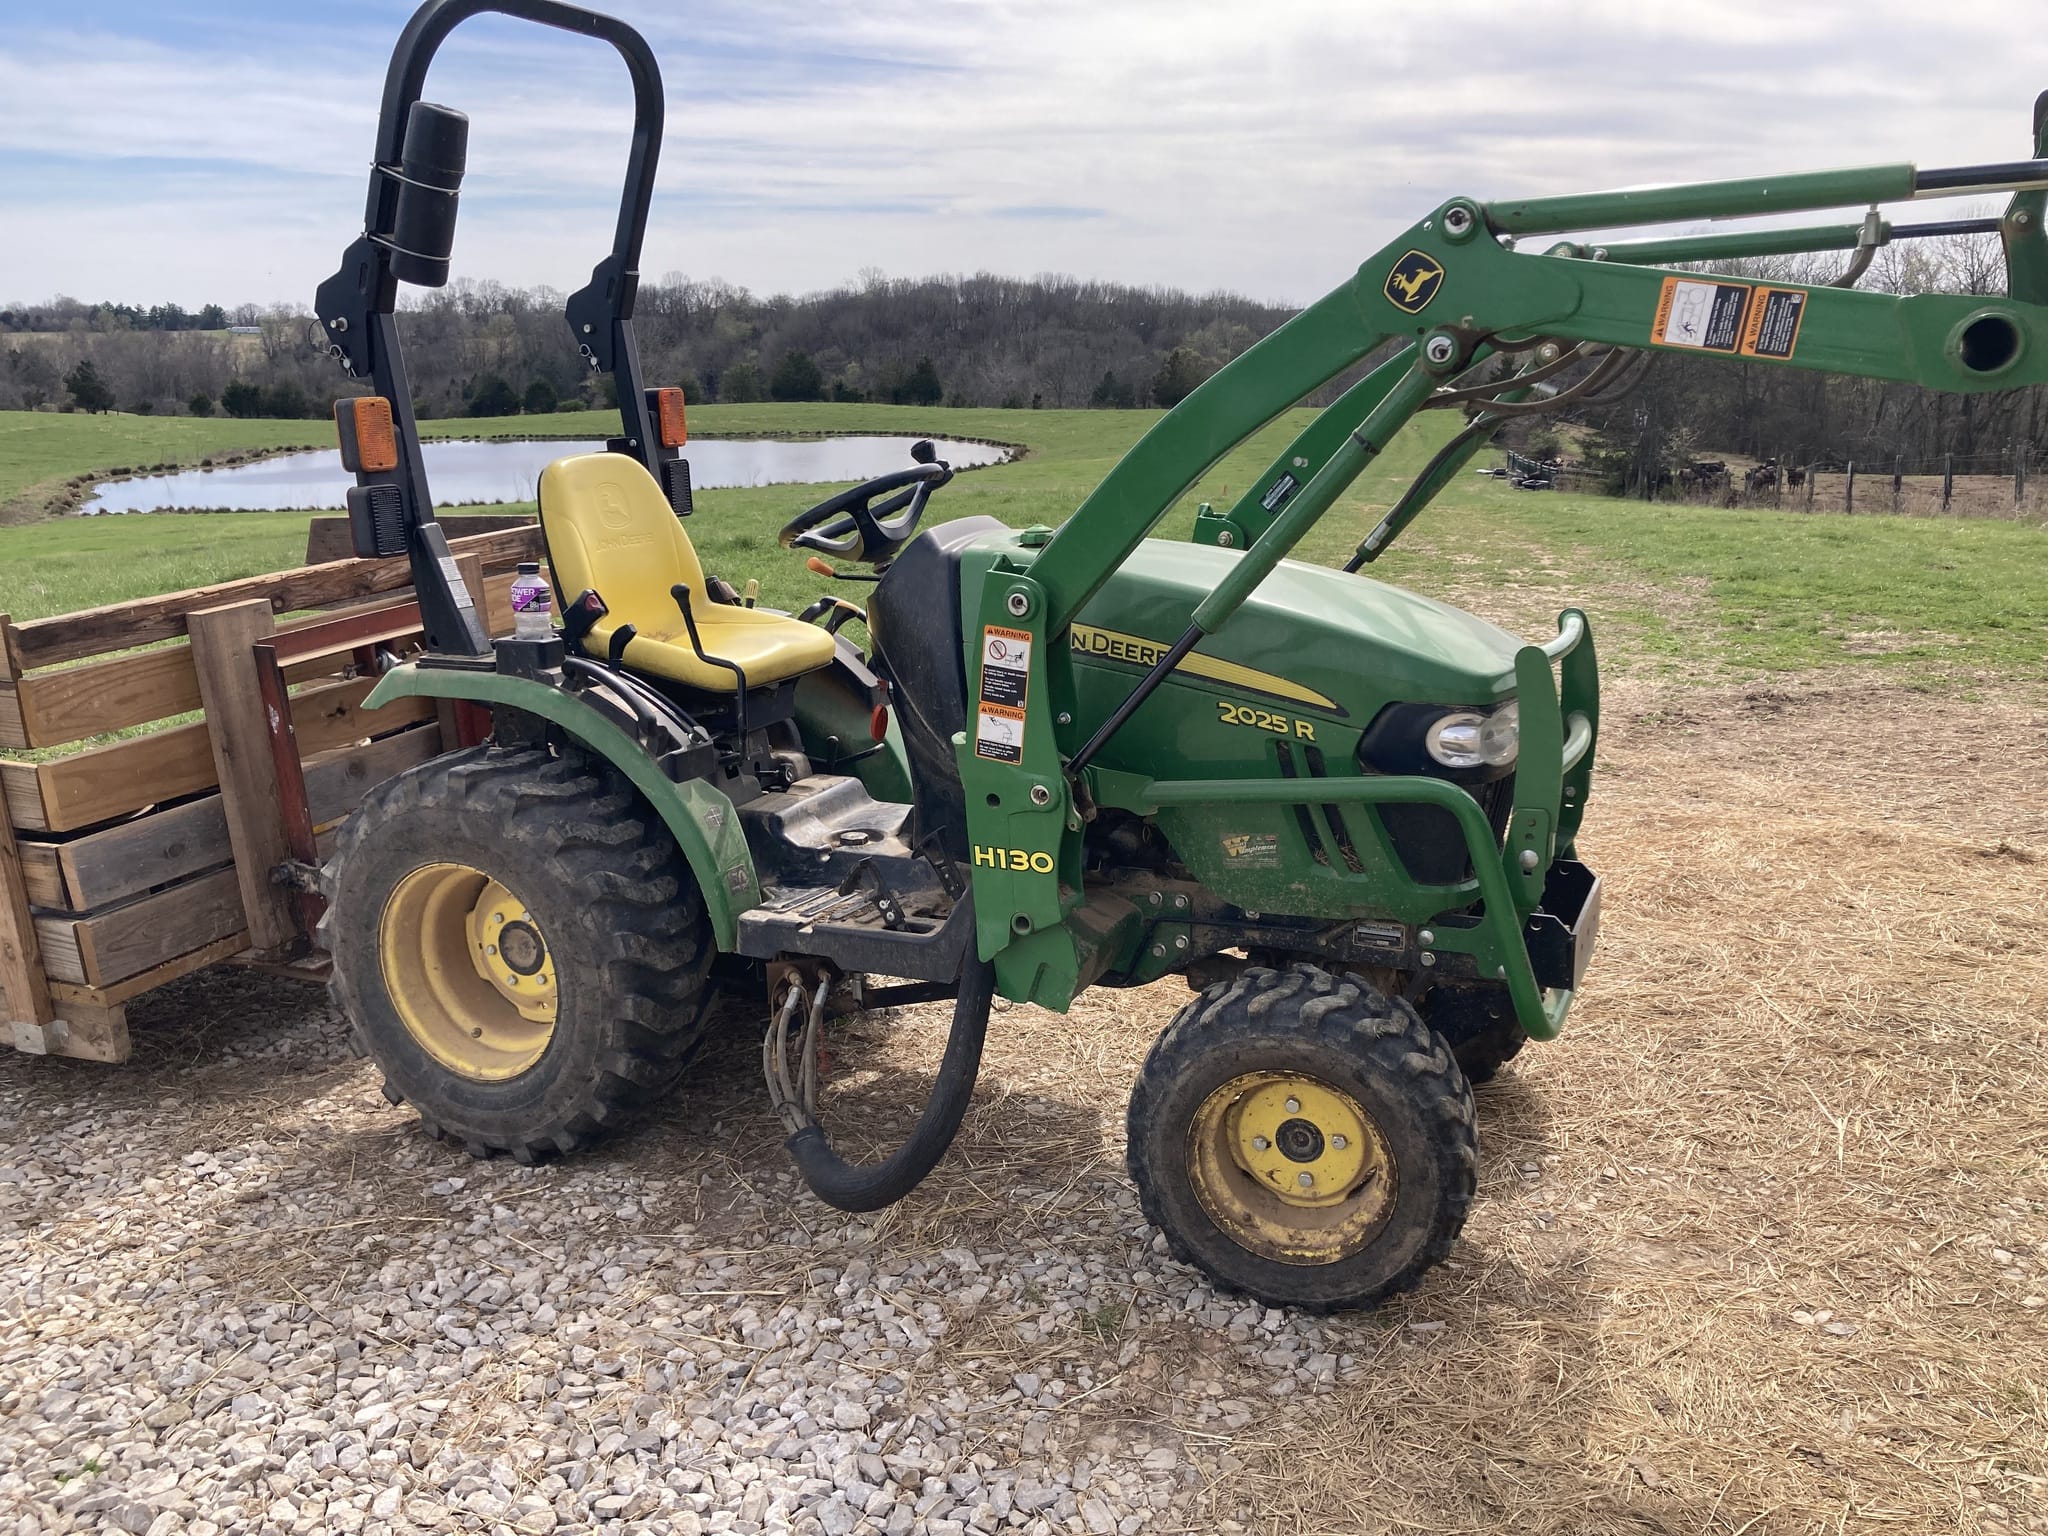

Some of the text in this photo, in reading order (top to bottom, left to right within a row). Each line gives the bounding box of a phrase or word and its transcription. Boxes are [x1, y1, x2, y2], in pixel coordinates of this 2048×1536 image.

[1658, 285, 1674, 330] WARNING
[1750, 294, 1767, 337] WARNING
[512, 588, 536, 596] OWER
[994, 627, 1030, 641] WARNING
[987, 706, 1024, 720] WARNING
[1217, 702, 1316, 742] 2025 R
[974, 844, 1055, 874] H130
